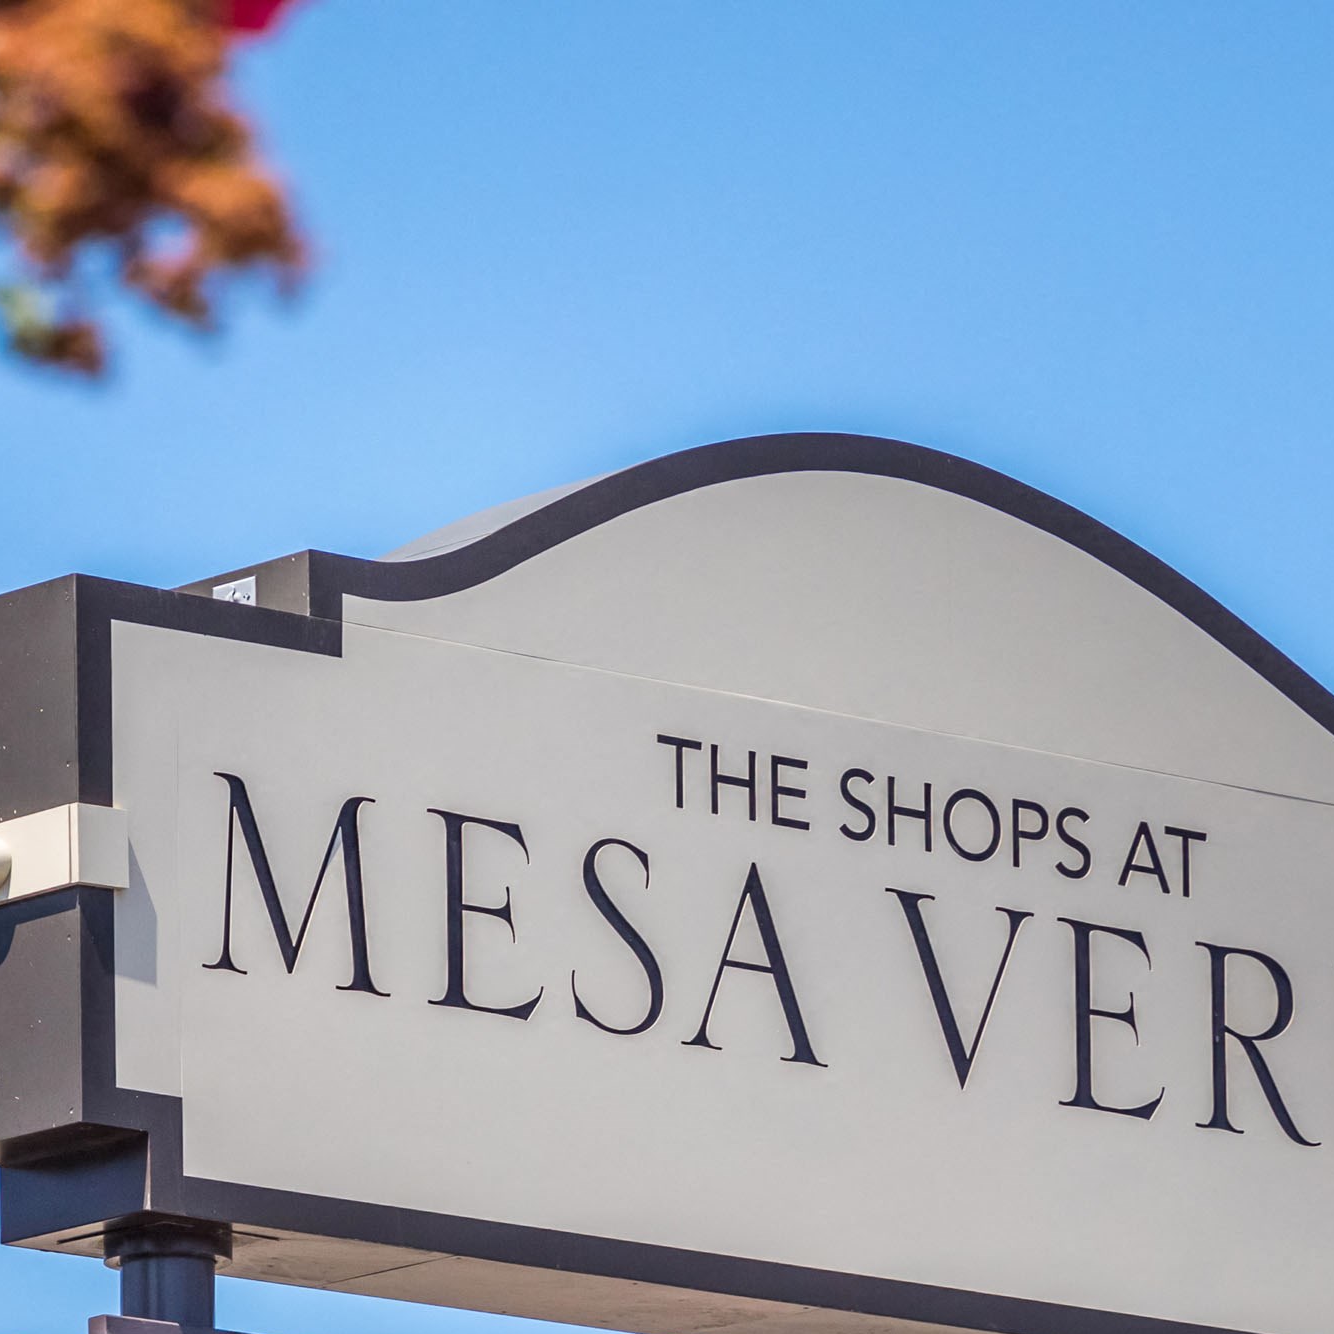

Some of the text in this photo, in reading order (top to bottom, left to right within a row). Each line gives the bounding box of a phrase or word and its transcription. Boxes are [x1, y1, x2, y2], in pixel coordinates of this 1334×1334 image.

[201, 771, 829, 1068] MESA
[656, 733, 1207, 898] THE SHOPS AT
